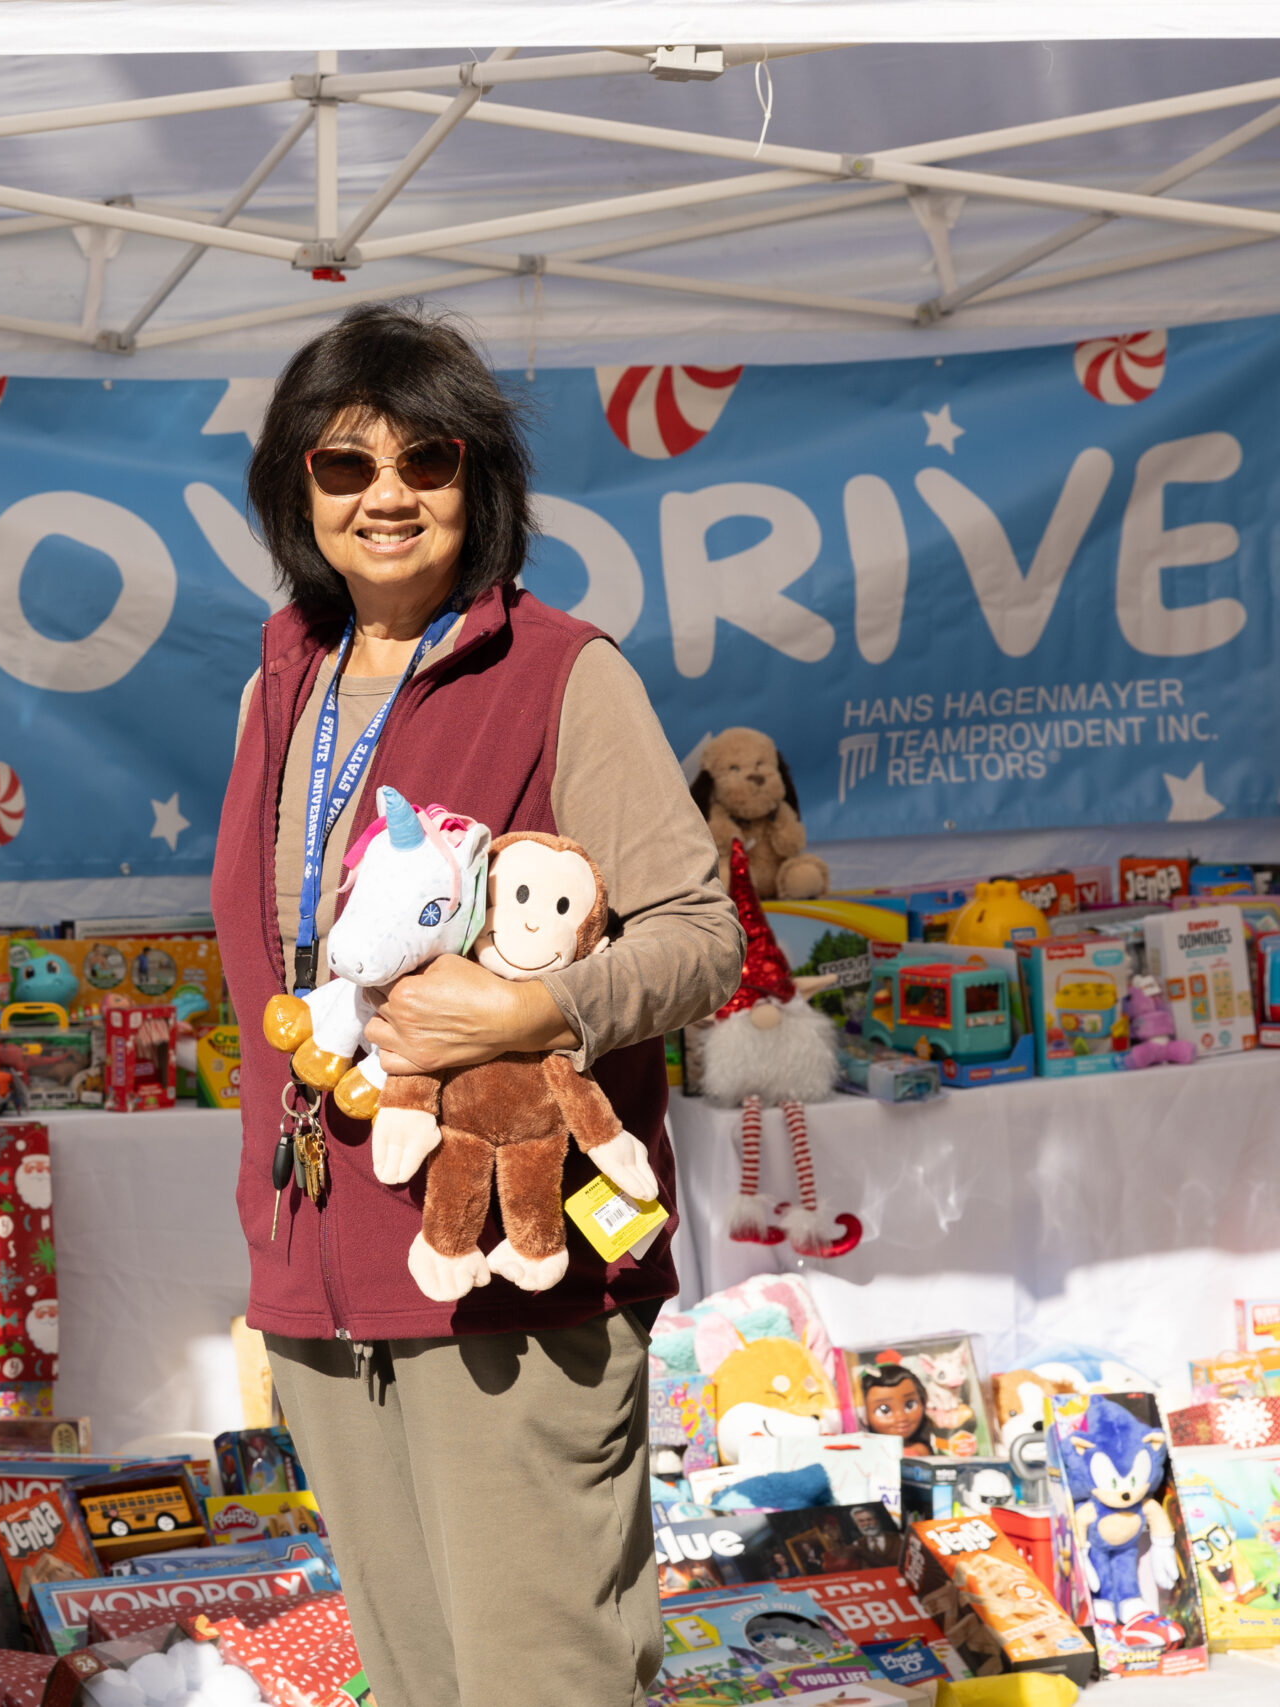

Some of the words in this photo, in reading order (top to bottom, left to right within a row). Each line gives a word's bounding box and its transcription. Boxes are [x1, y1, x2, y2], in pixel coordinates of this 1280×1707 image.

[843, 694, 934, 728] HANS
[943, 678, 1186, 720] HAGENMAYER
[316, 715, 335, 763] STATE
[885, 716, 1147, 758] TEAMPROVIDENT
[1156, 711, 1220, 743] INC.
[339, 743, 369, 793] STATE
[305, 768, 326, 858] UNIVERSITY
[1124, 865, 1183, 902] Jenga
[925, 1519, 997, 1556] Jenga
[66, 1574, 301, 1622] MONOPOLY
[76, 1658, 98, 1673] 24
[796, 1673, 839, 1687] YOUR
[841, 1671, 870, 1683] LIFE
[880, 1652, 925, 1671] Phase
[898, 1659, 923, 1676] 10
